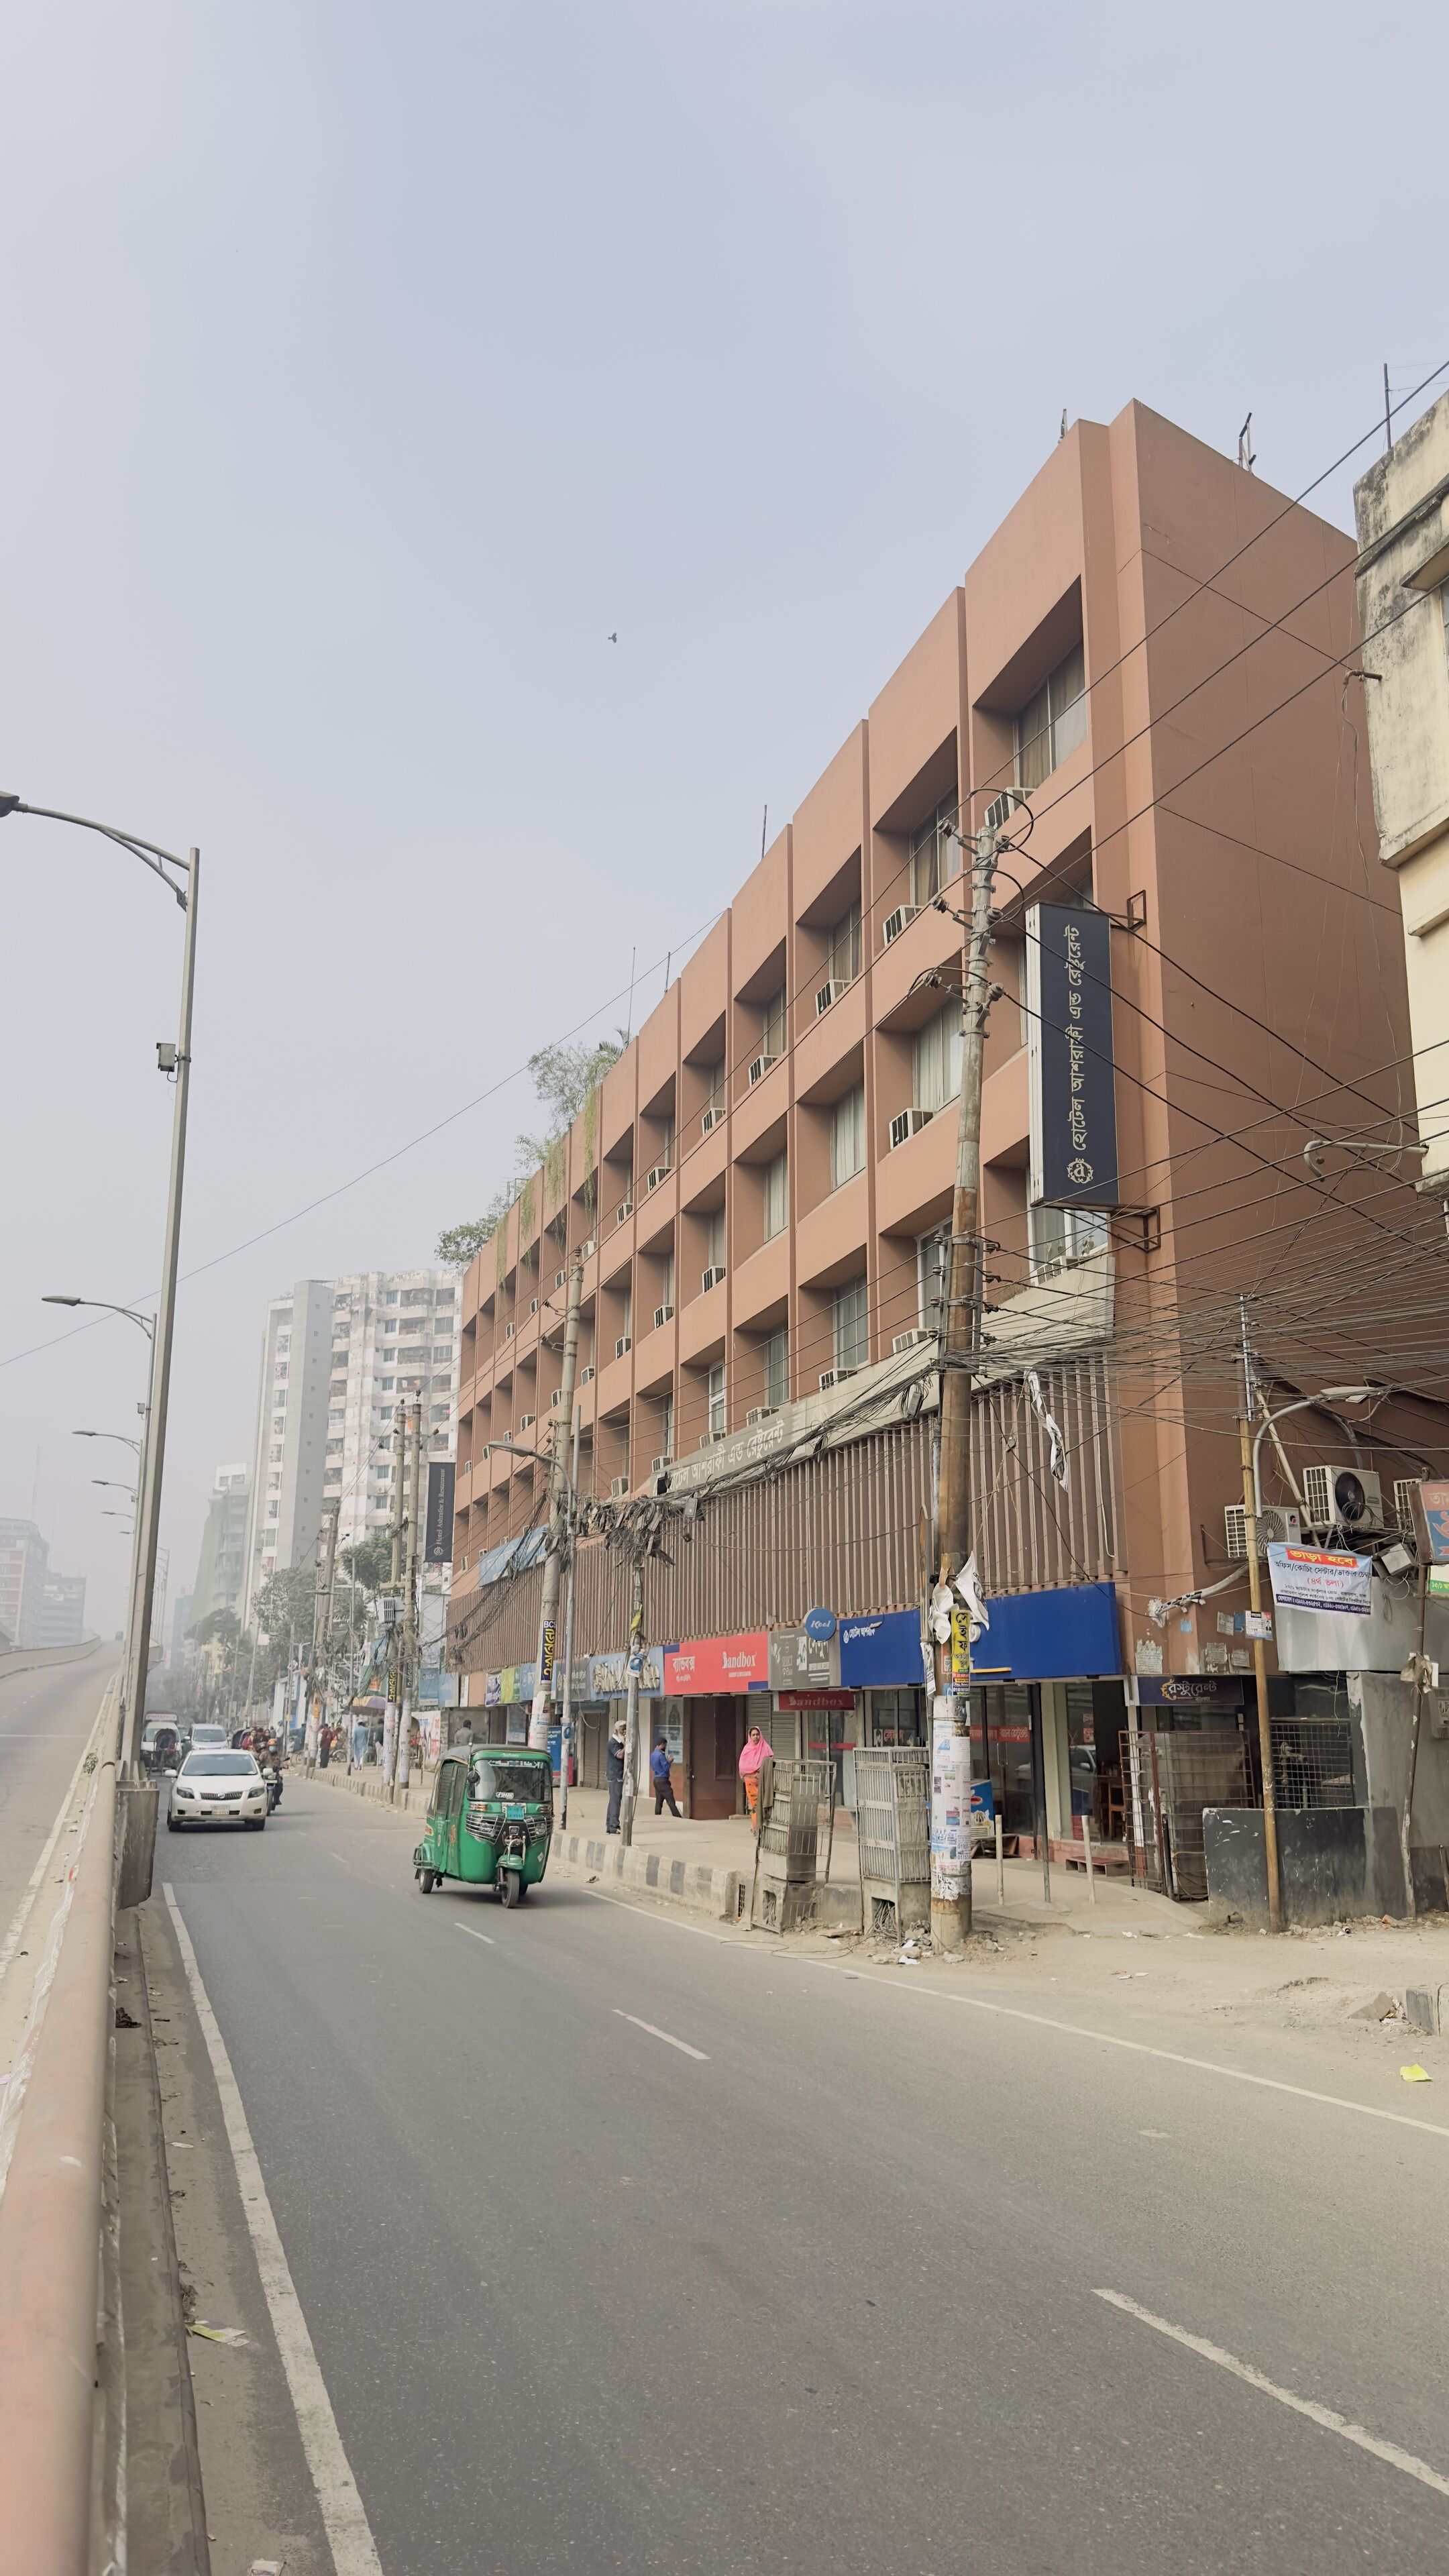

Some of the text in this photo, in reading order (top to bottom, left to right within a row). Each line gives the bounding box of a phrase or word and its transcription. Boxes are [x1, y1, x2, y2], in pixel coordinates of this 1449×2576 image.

[1068, 1097, 1087, 1151] হোটেল
[1291, 1550, 1354, 1566] ভাড়া হবে
[811, 1619, 832, 1629] Kool
